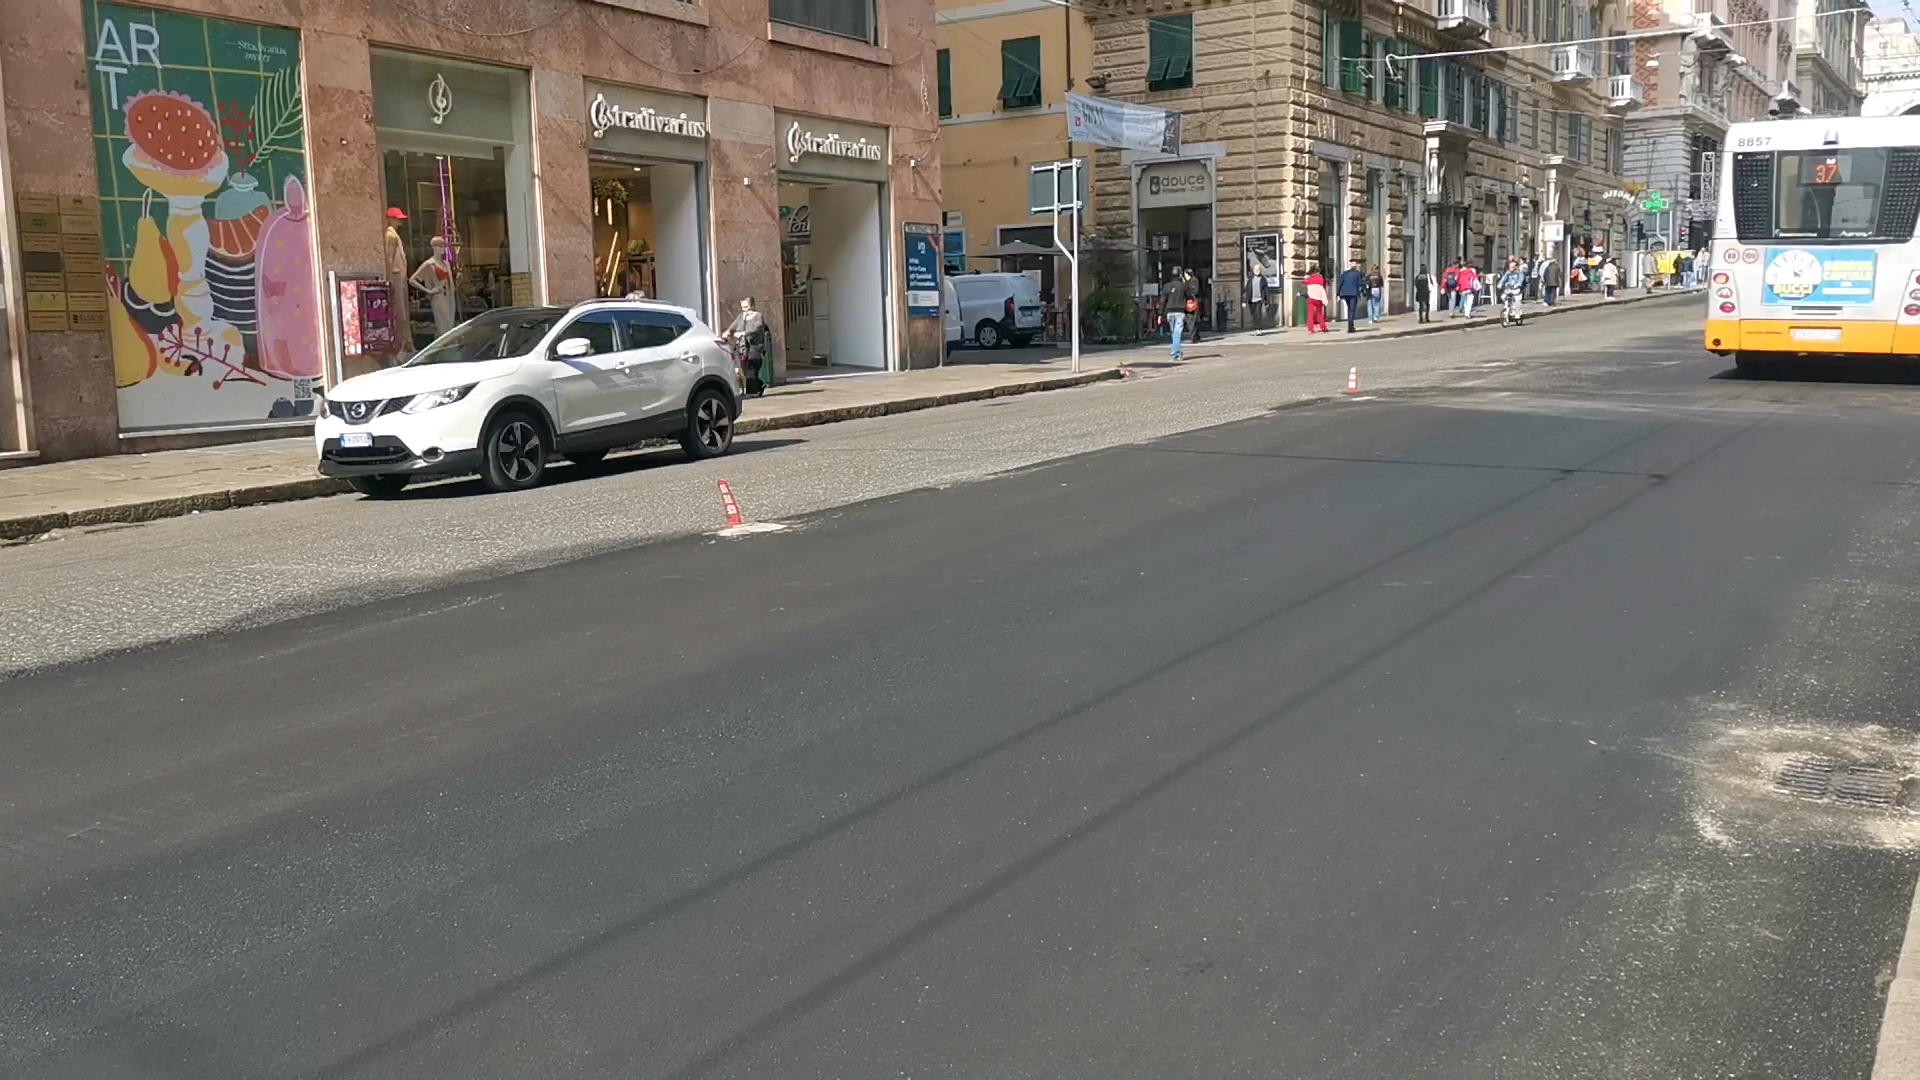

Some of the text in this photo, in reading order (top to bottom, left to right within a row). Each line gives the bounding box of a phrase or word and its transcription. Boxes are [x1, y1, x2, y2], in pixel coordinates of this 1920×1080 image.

[95, 18, 163, 69] AR
[1737, 136, 1771, 147] 8857
[1160, 174, 1205, 187] douce
[1815, 164, 1837, 183] 37
